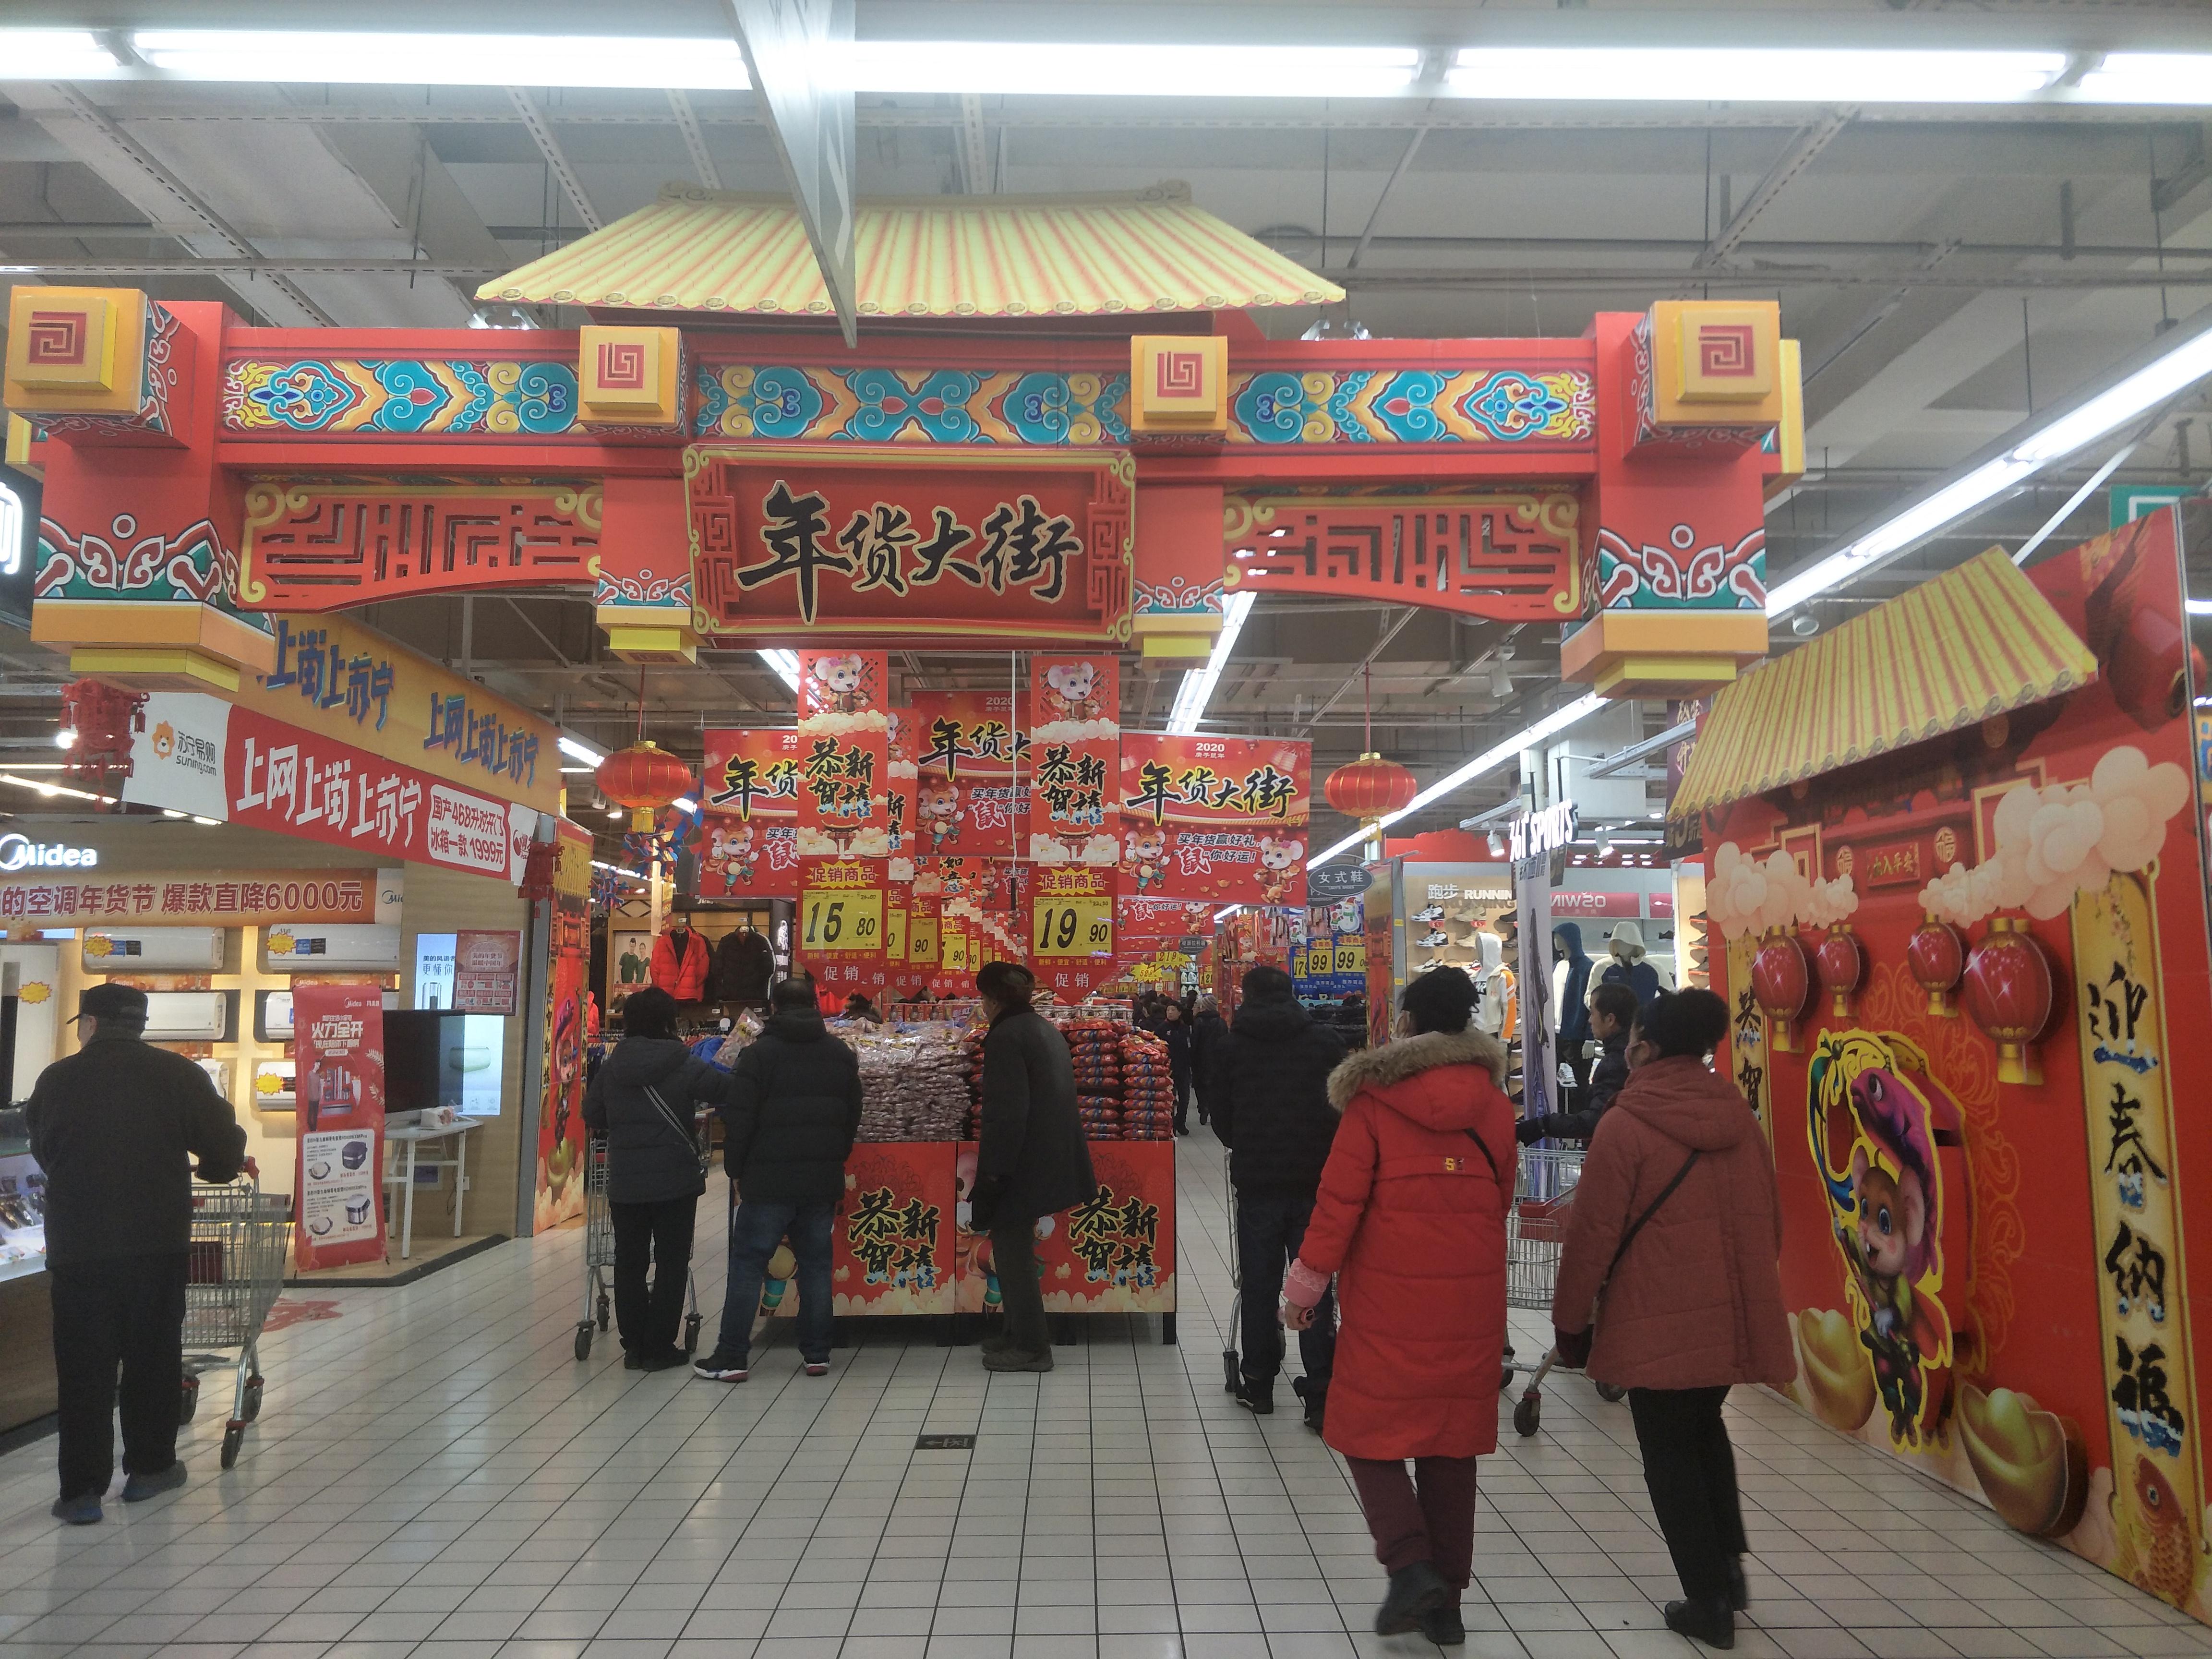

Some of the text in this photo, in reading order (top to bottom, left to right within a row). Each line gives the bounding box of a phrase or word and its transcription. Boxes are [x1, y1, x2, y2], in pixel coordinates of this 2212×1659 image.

[735, 480, 1084, 625] 年货大街
[259, 619, 394, 731] 上街上苏宁
[178, 731, 216, 764] 苏宁易购
[423, 692, 540, 788] 上网上街上苏宁
[1195, 743, 1225, 752] 2020
[176, 755, 216, 776] suning.com
[236, 737, 422, 848] 上网上街上苏宁
[1125, 759, 1298, 826] 年货大街
[432, 794, 504, 837] 国产468升对开门
[1529, 798, 1573, 855] SPORTS
[0, 834, 97, 870] Midea
[431, 827, 469, 857] 冰箱一款
[469, 837, 504, 865] 1999元
[811, 866, 876, 883] 促销商品
[1041, 873, 1106, 890] 促销商品
[1318, 870, 1364, 884] 女式鞋
[161, 880, 362, 914] 爆款直降6000元
[1428, 884, 1459, 900] 跑步
[914, 938, 929, 953] 90
[953, 950, 965, 962] 90
[1159, 951, 1177, 962] 219
[1311, 954, 1328, 971] 99
[1337, 951, 1355, 969] 99
[423, 963, 453, 976] 更懂你
[823, 965, 859, 982] 促销
[295, 977, 318, 986] Midea
[896, 974, 922, 986] 促销
[932, 979, 953, 988] 促销
[1054, 972, 1090, 988] 促销
[344, 997, 362, 1008] Midea
[312, 1021, 364, 1039] 火力全开
[2088, 961, 2185, 1459] 迎春纳福
